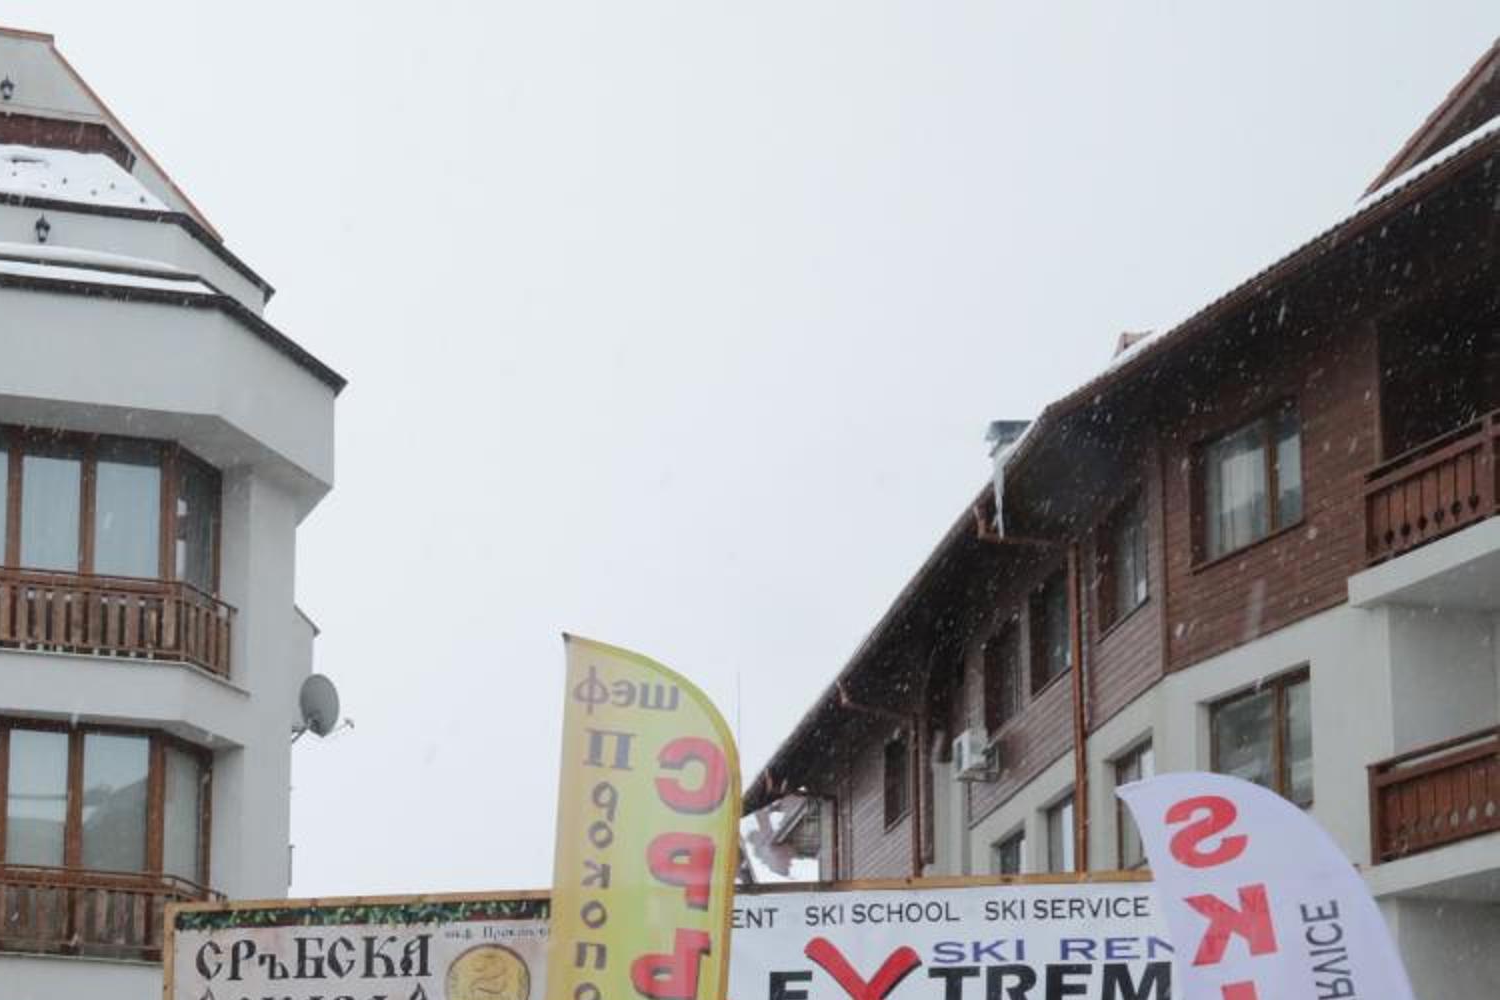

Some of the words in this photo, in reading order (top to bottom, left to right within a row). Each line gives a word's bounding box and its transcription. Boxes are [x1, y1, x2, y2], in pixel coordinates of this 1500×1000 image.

[731, 908, 778, 929] ENT
[805, 903, 844, 926] SKI
[852, 900, 960, 925] SCHOOL
[984, 899, 1026, 921] SKI
[1033, 896, 1150, 918] SERVICE
[932, 940, 1025, 963] SKI
